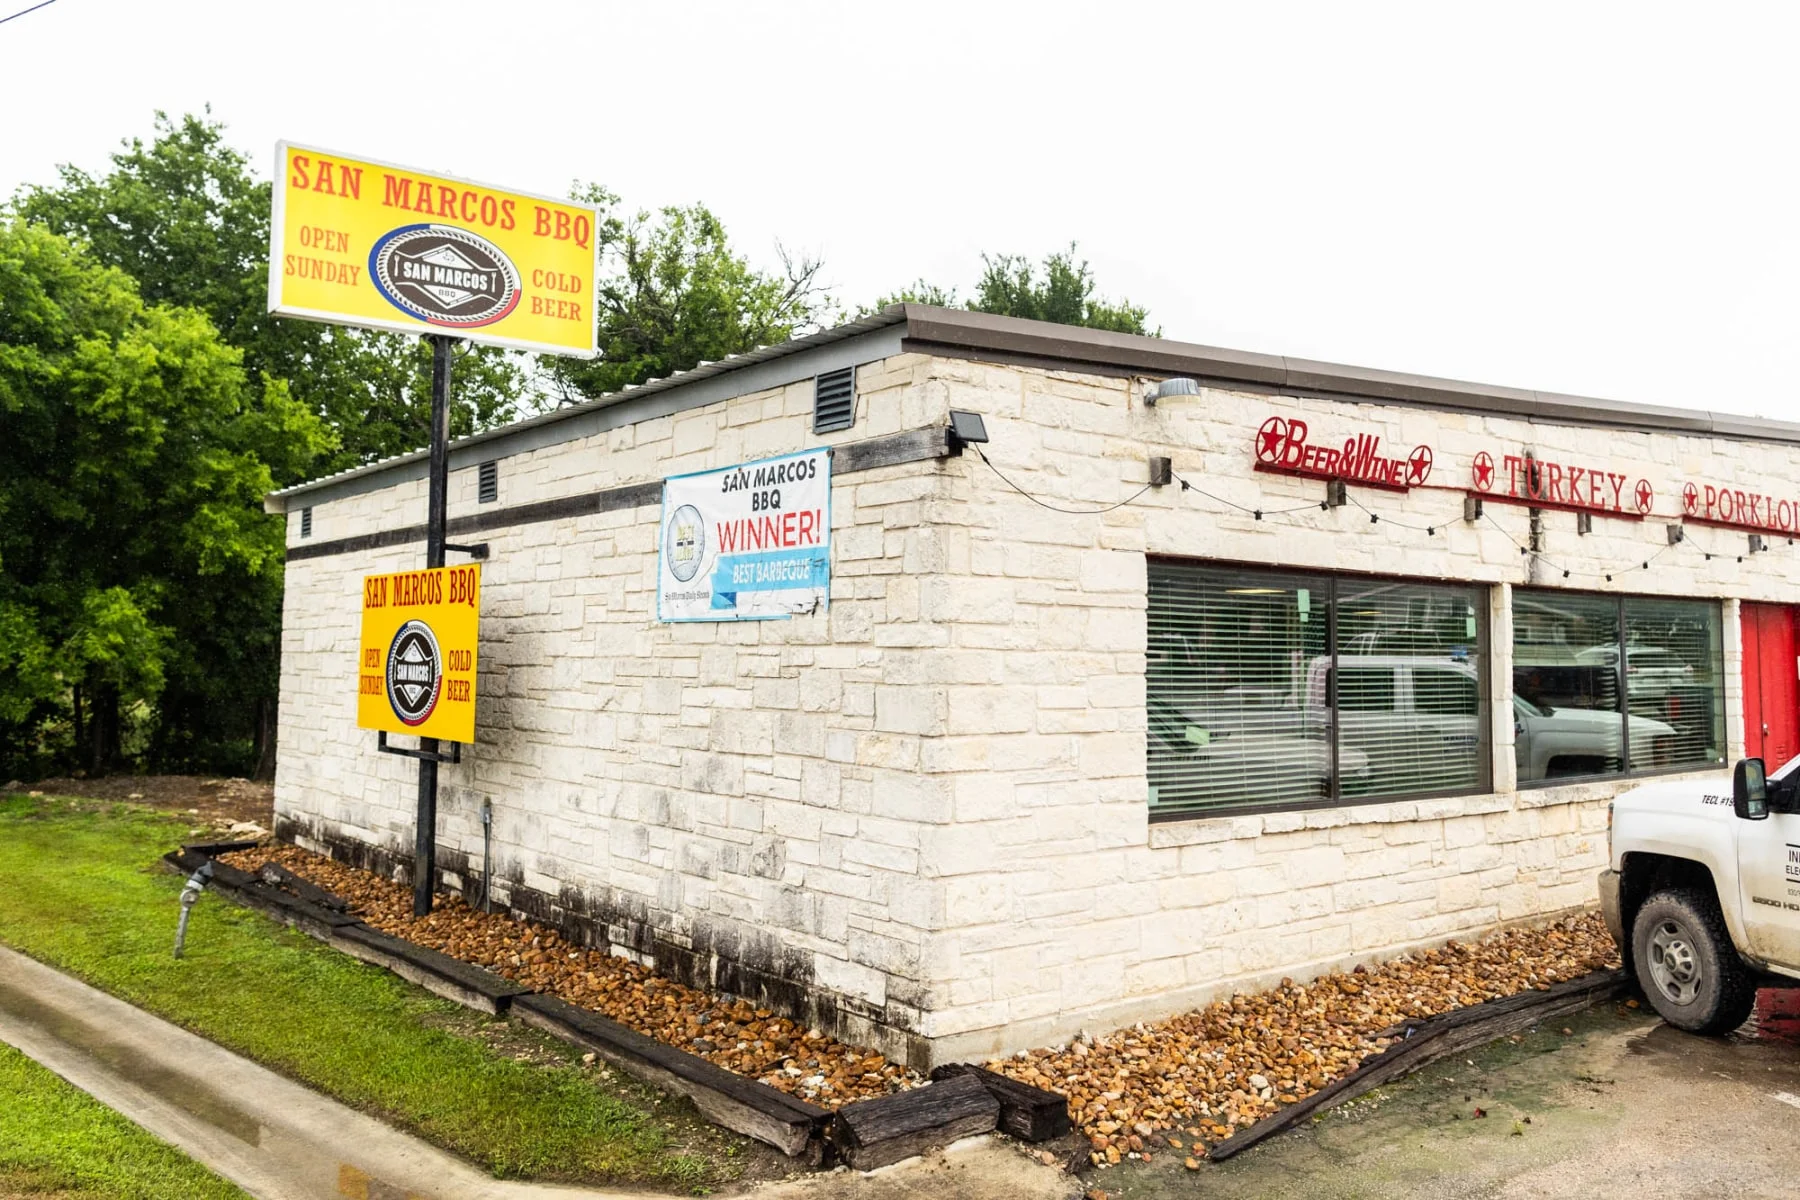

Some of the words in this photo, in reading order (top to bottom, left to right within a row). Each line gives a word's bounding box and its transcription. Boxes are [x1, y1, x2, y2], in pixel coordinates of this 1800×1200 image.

[292, 155, 363, 200] SAN
[382, 174, 516, 231] MARCOS
[533, 206, 590, 250] BBQ
[300, 226, 349, 254] OPEN
[285, 255, 361, 287] SUNDAY
[403, 261, 431, 281] SAN
[434, 267, 488, 291] MARCOS
[532, 269, 582, 294] COLD
[531, 297, 582, 322] BEER
[722, 470, 751, 493] SAN
[753, 458, 816, 488] MARCOS
[1504, 454, 1627, 512] TURKEY
[752, 489, 781, 512] BBQ
[717, 509, 821, 553] WINNER!
[733, 563, 755, 584] BEST
[756, 558, 810, 583] BARBEQUE
[366, 577, 387, 608] SAN
[393, 571, 442, 607] MARCOS
[449, 568, 476, 608] BBQ
[365, 648, 381, 668] OPEN
[449, 650, 472, 671] COLD
[360, 675, 384, 695] SUNDAY
[447, 680, 470, 702] BEER
[1702, 795, 1718, 805] TECL
[1788, 850, 1800, 863] IN
[1785, 865, 1800, 876] ELE
